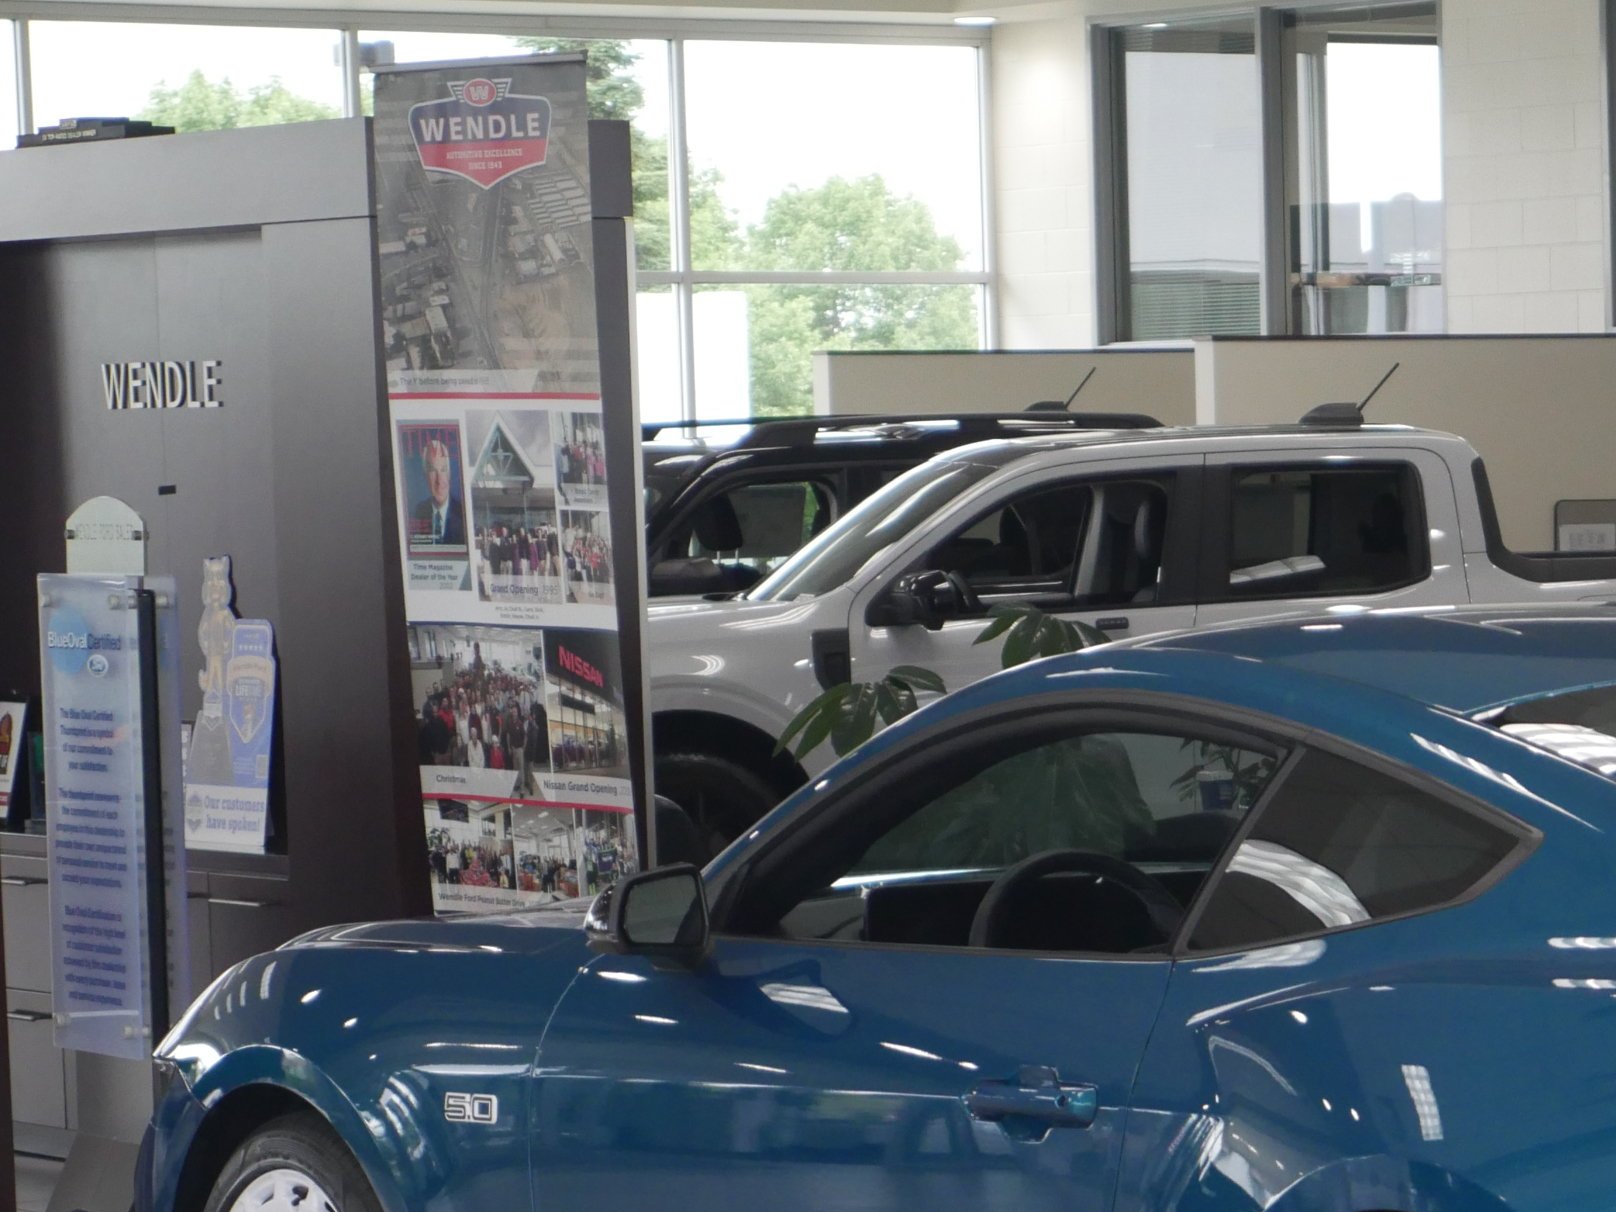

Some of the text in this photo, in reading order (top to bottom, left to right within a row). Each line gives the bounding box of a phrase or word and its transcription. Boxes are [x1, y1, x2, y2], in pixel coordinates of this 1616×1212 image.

[470, 86, 489, 100] W
[419, 113, 541, 141] WENDLE
[101, 361, 221, 410] WENDLE
[509, 584, 539, 595] Opening
[558, 645, 604, 688] NISSAN
[436, 773, 467, 784] Christmas
[543, 779, 566, 790] Nissan
[568, 781, 588, 793] Grand
[590, 783, 617, 796] Opening
[204, 796, 265, 812] Our customers
[206, 814, 260, 834] have spoken!
[444, 1092, 498, 1125] 5.0
